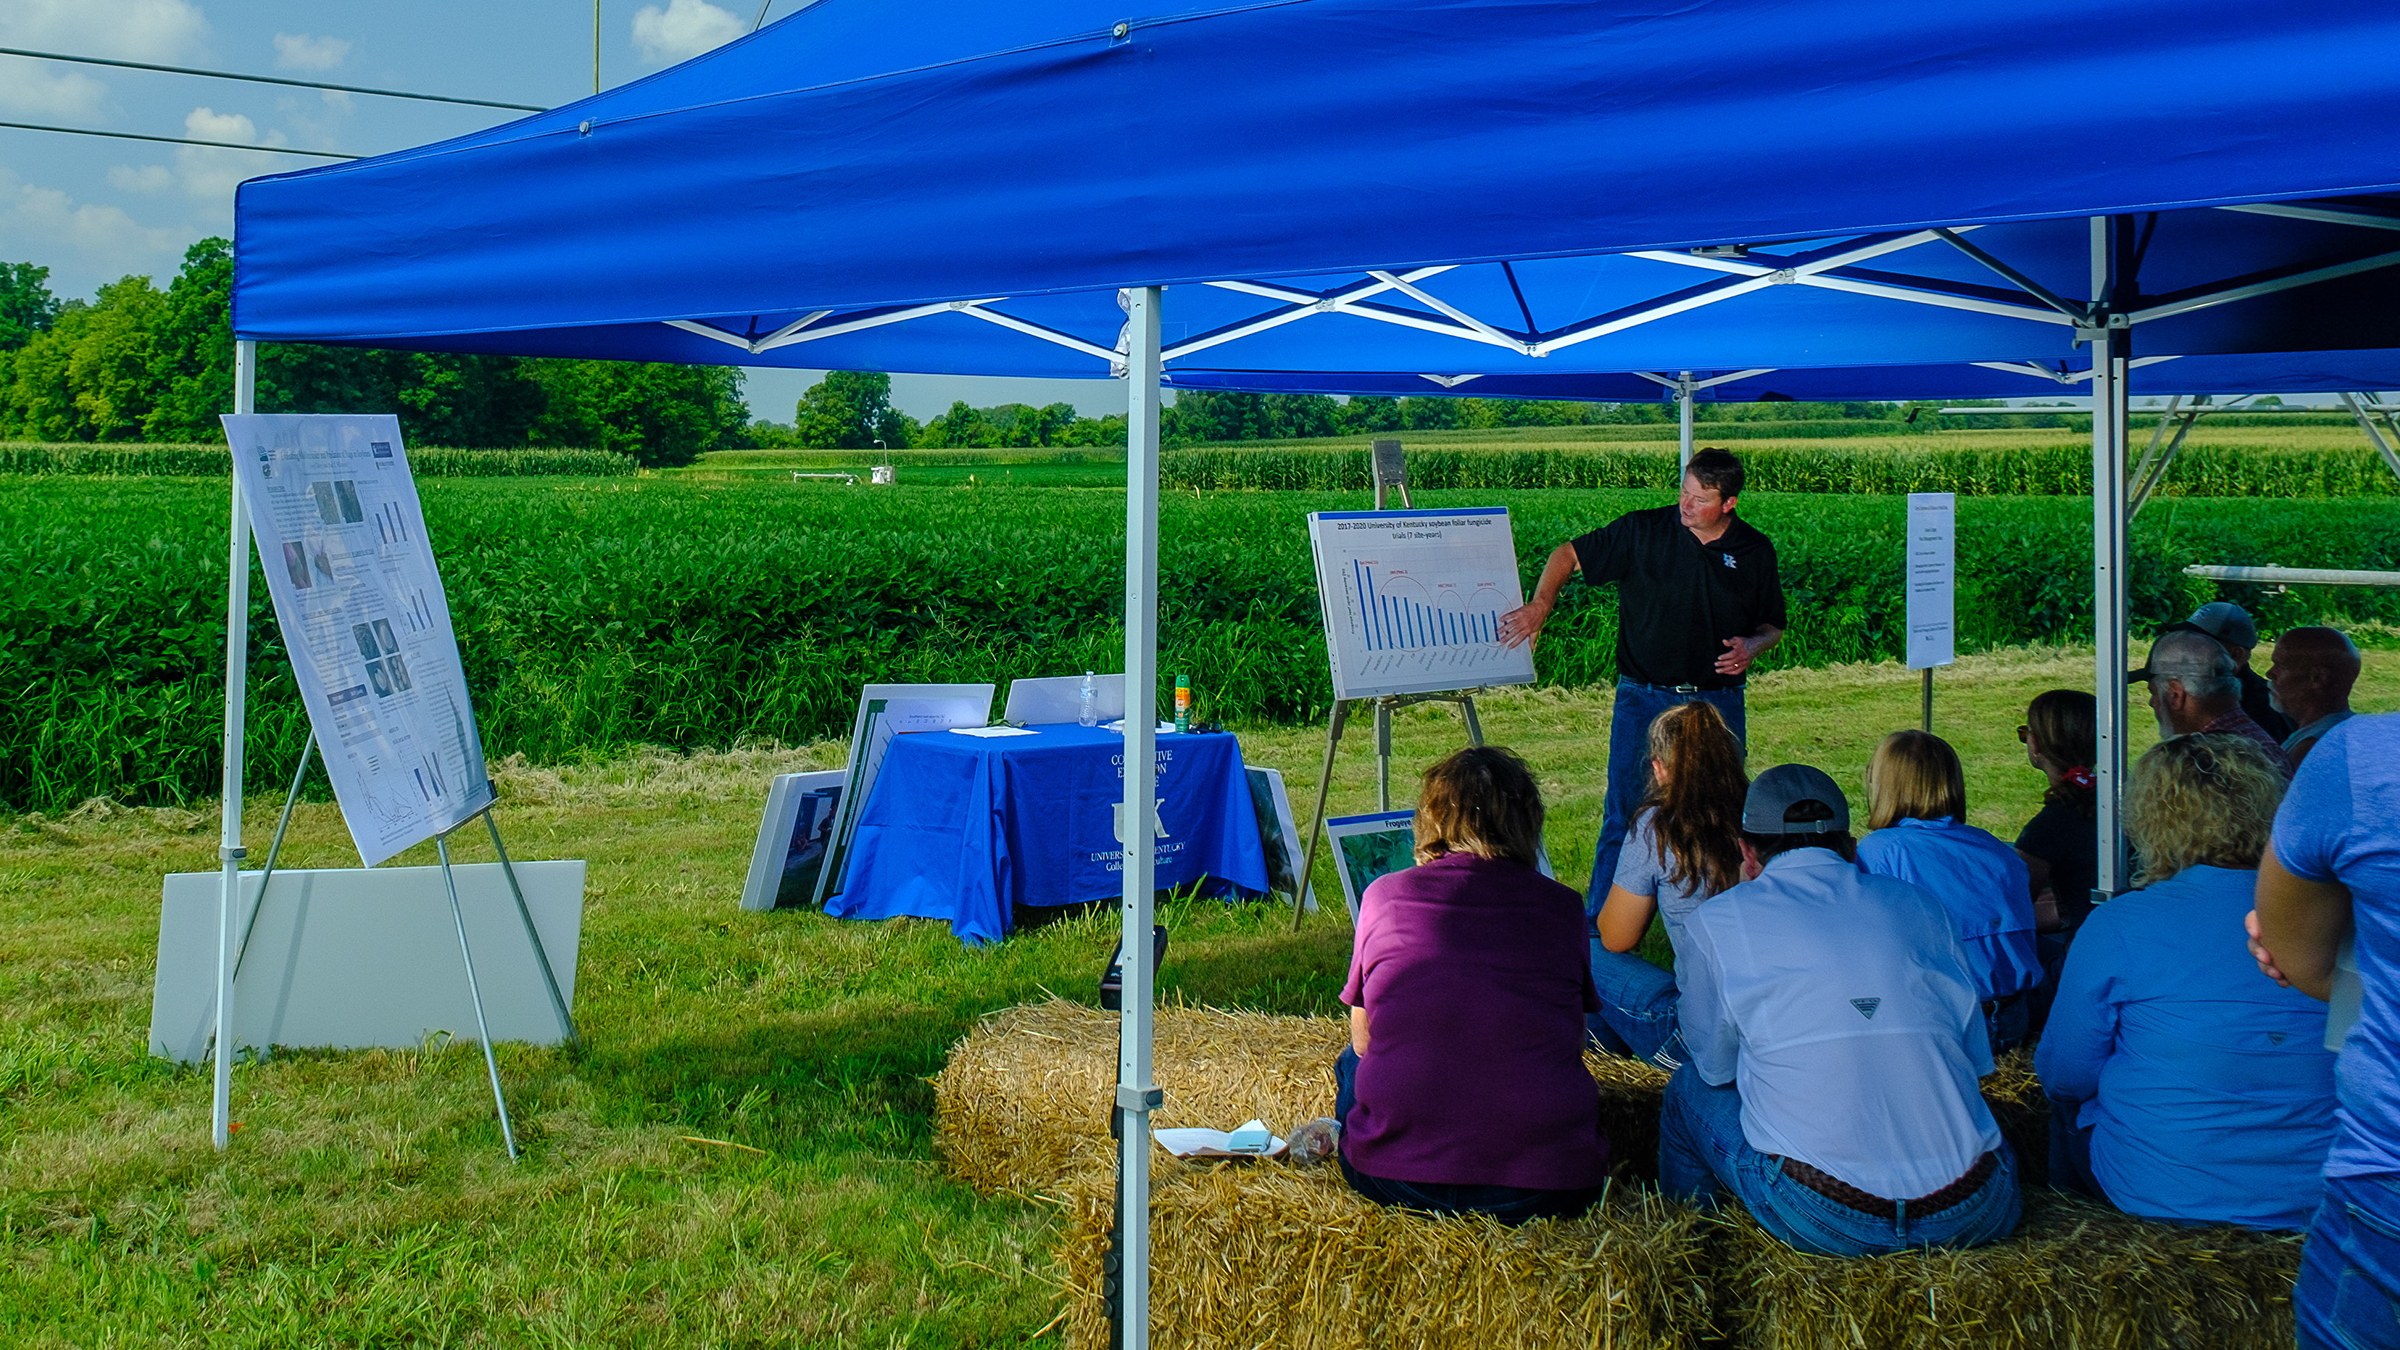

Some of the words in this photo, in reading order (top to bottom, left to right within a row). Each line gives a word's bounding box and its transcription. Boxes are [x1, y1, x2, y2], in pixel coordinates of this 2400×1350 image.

[1368, 522, 1395, 530] University
[1396, 521, 1402, 529] of
[1403, 521, 1428, 529] Kentucky
[1428, 520, 1451, 529] soybean
[1467, 518, 1492, 527] fungicide
[1392, 532, 1407, 540] trials
[1385, 820, 1411, 828] Frogeye
[1154, 841, 1186, 855] ENTUCKY
